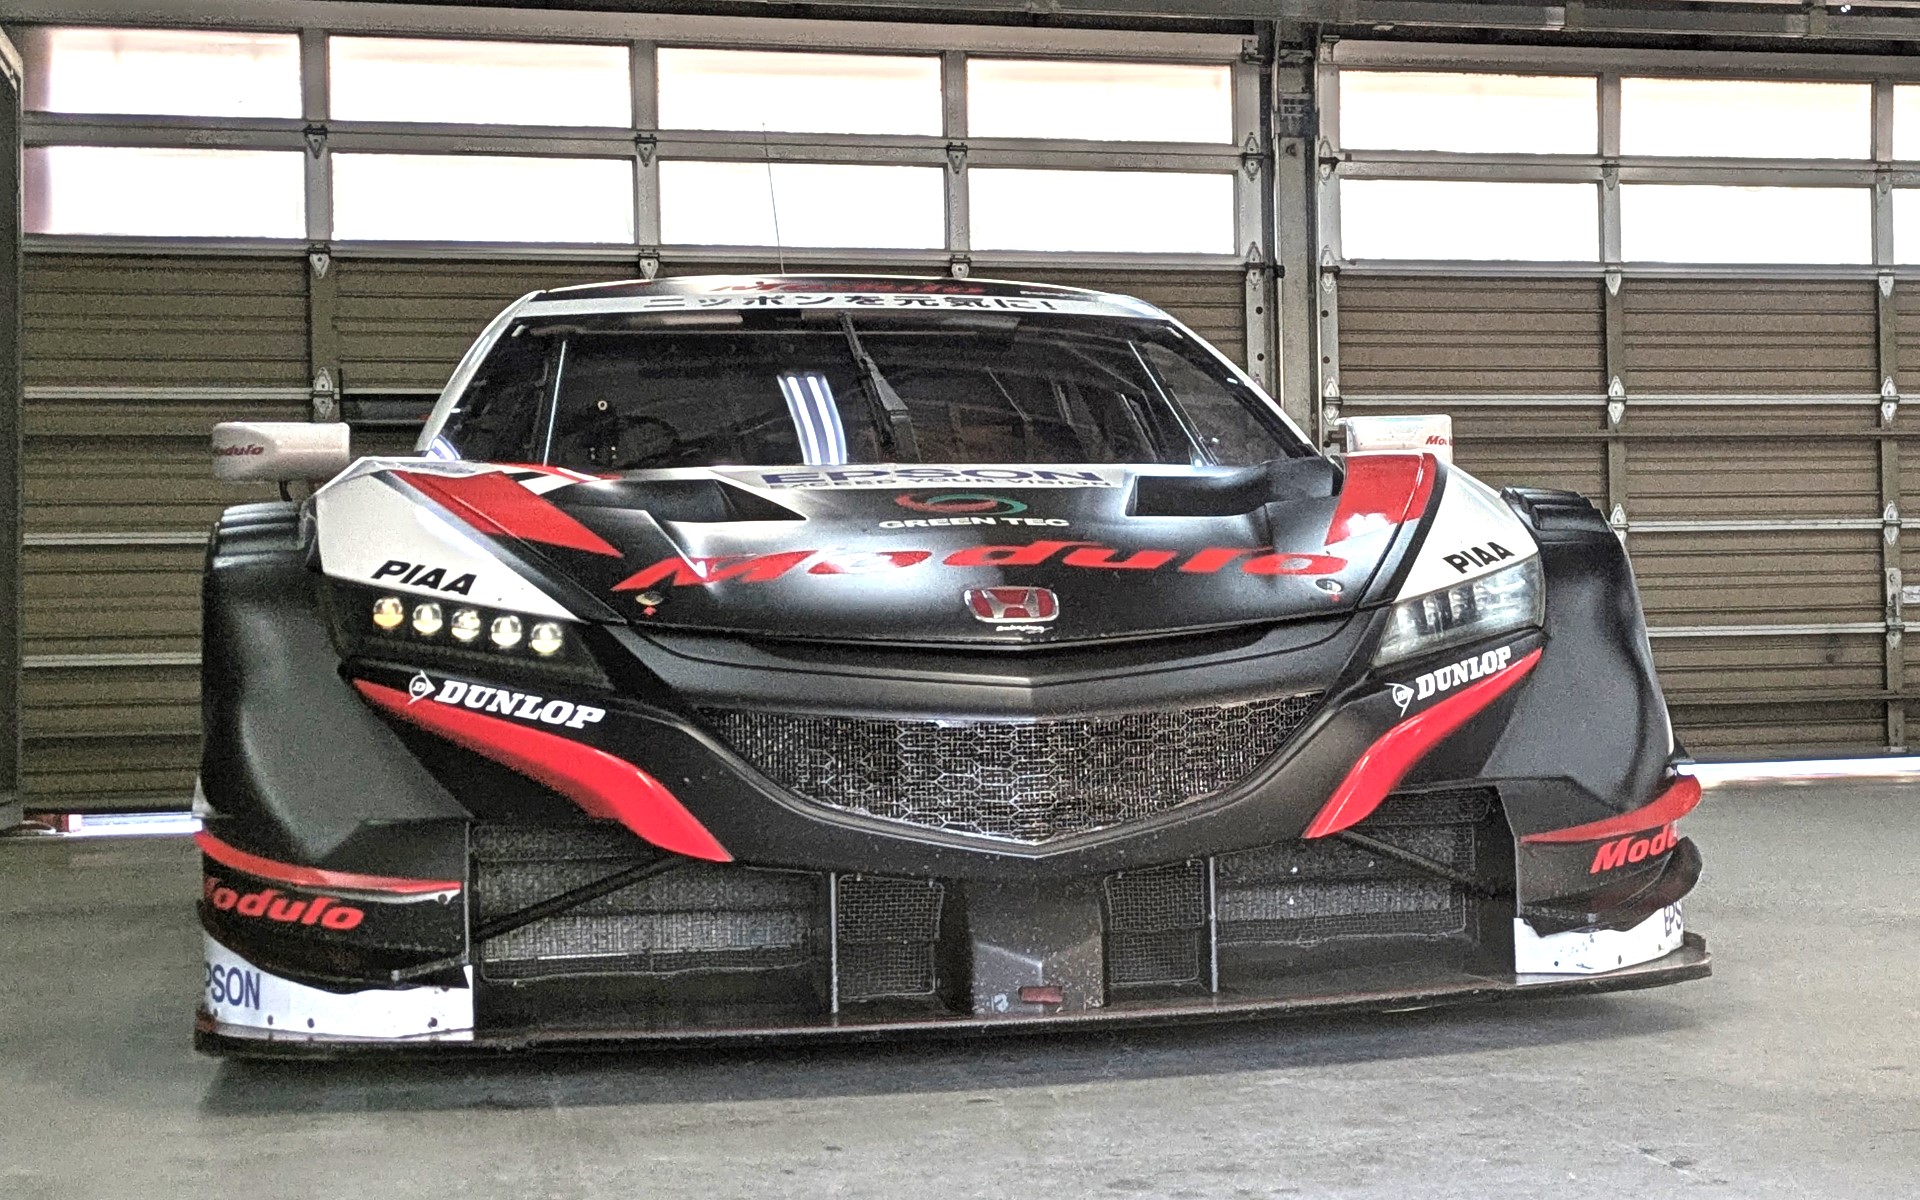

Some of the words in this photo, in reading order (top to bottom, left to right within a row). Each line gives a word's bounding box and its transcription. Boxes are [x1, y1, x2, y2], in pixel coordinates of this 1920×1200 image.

[761, 468, 1105, 484] EPSON
[878, 517, 996, 528] GREEN
[1002, 517, 1070, 527] TEC
[610, 540, 1348, 591] Modulo
[1442, 541, 1515, 574] PIAA
[370, 559, 477, 596] PIAA
[1416, 645, 1512, 701] DUNLOP
[434, 680, 606, 729] DUNLOP
